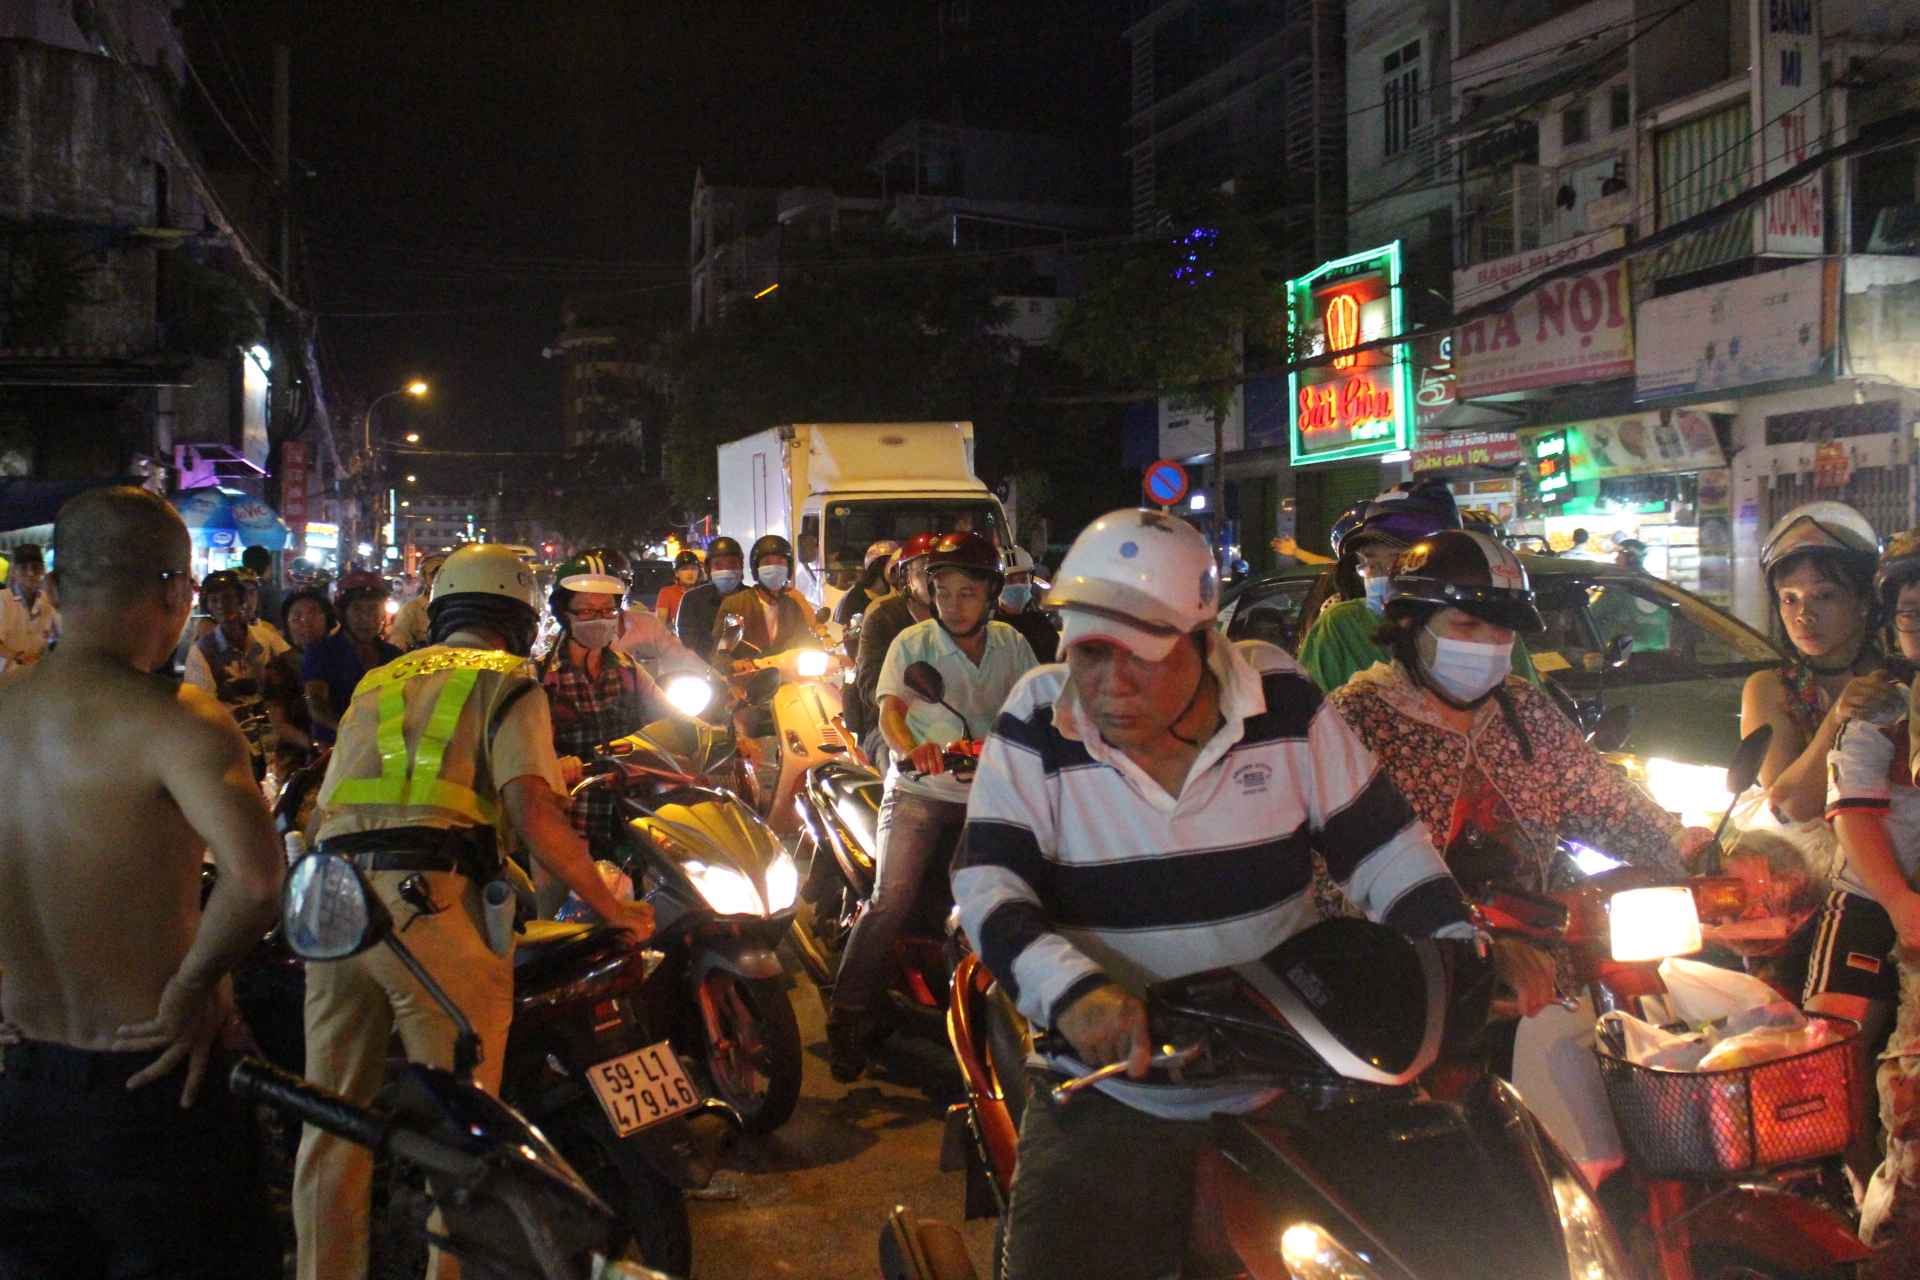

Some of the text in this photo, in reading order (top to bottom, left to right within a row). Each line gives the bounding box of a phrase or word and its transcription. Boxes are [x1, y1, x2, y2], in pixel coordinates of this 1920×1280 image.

[1468, 449, 1490, 464] 10%
[602, 1051, 669, 1094] 59-L1
[612, 1078, 692, 1127] 479.46
